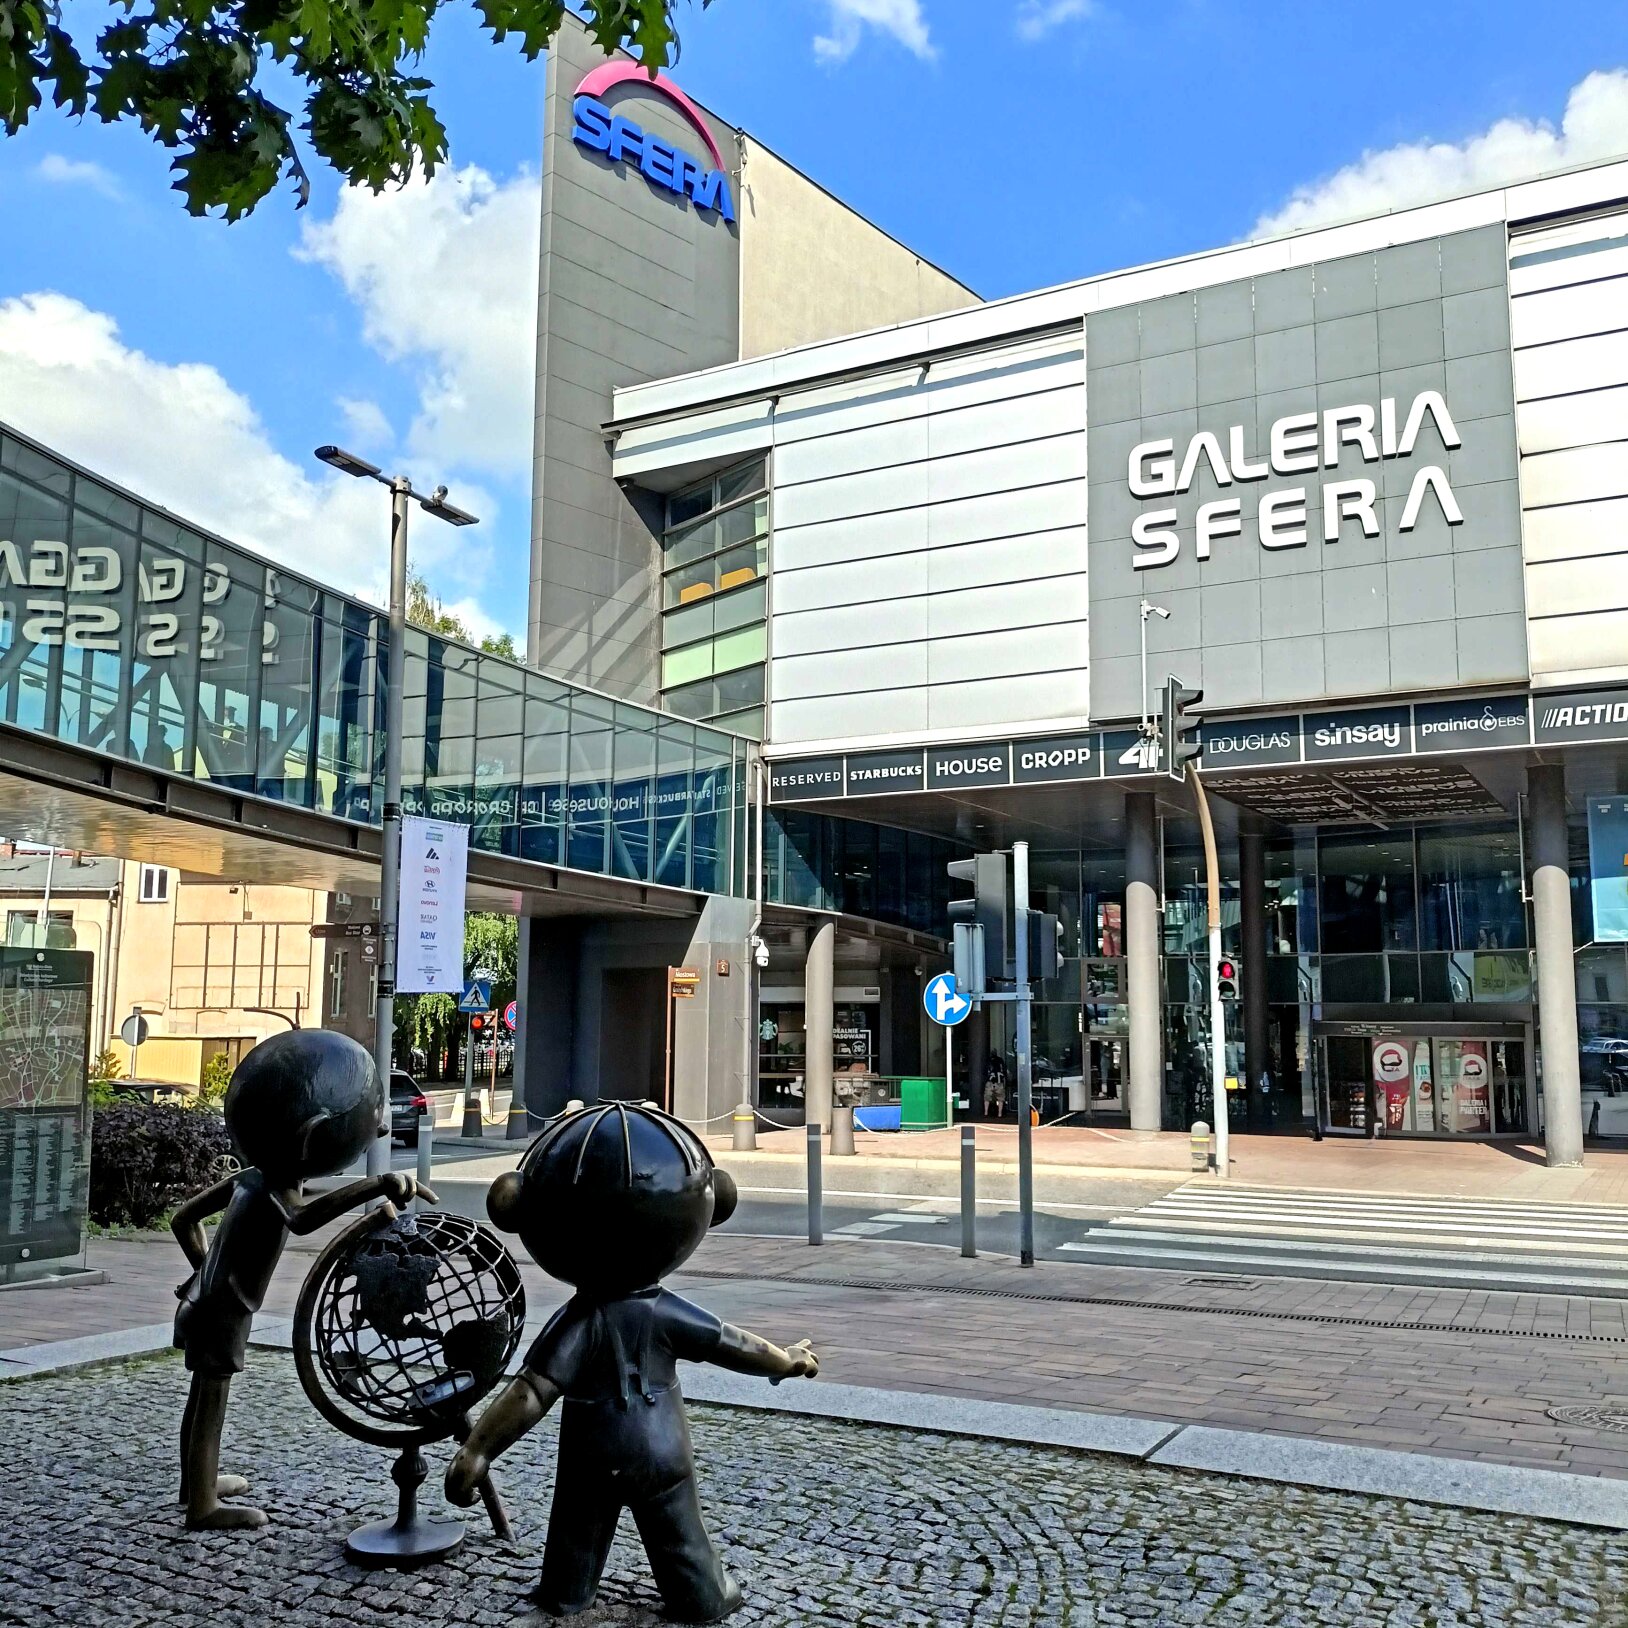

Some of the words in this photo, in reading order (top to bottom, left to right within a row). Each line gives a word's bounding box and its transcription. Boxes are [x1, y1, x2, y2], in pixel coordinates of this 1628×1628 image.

[572, 95, 736, 223] SFERA
[1128, 390, 1462, 500] GALERIA
[1131, 465, 1464, 571] SFERA
[1498, 714, 1525, 727] EBS
[1209, 731, 1291, 754] DOUGLAS
[1314, 722, 1400, 747] sinsay
[1021, 747, 1091, 770] CROPP
[772, 771, 842, 787] RESERVED
[850, 765, 922, 781] STARBUCKS
